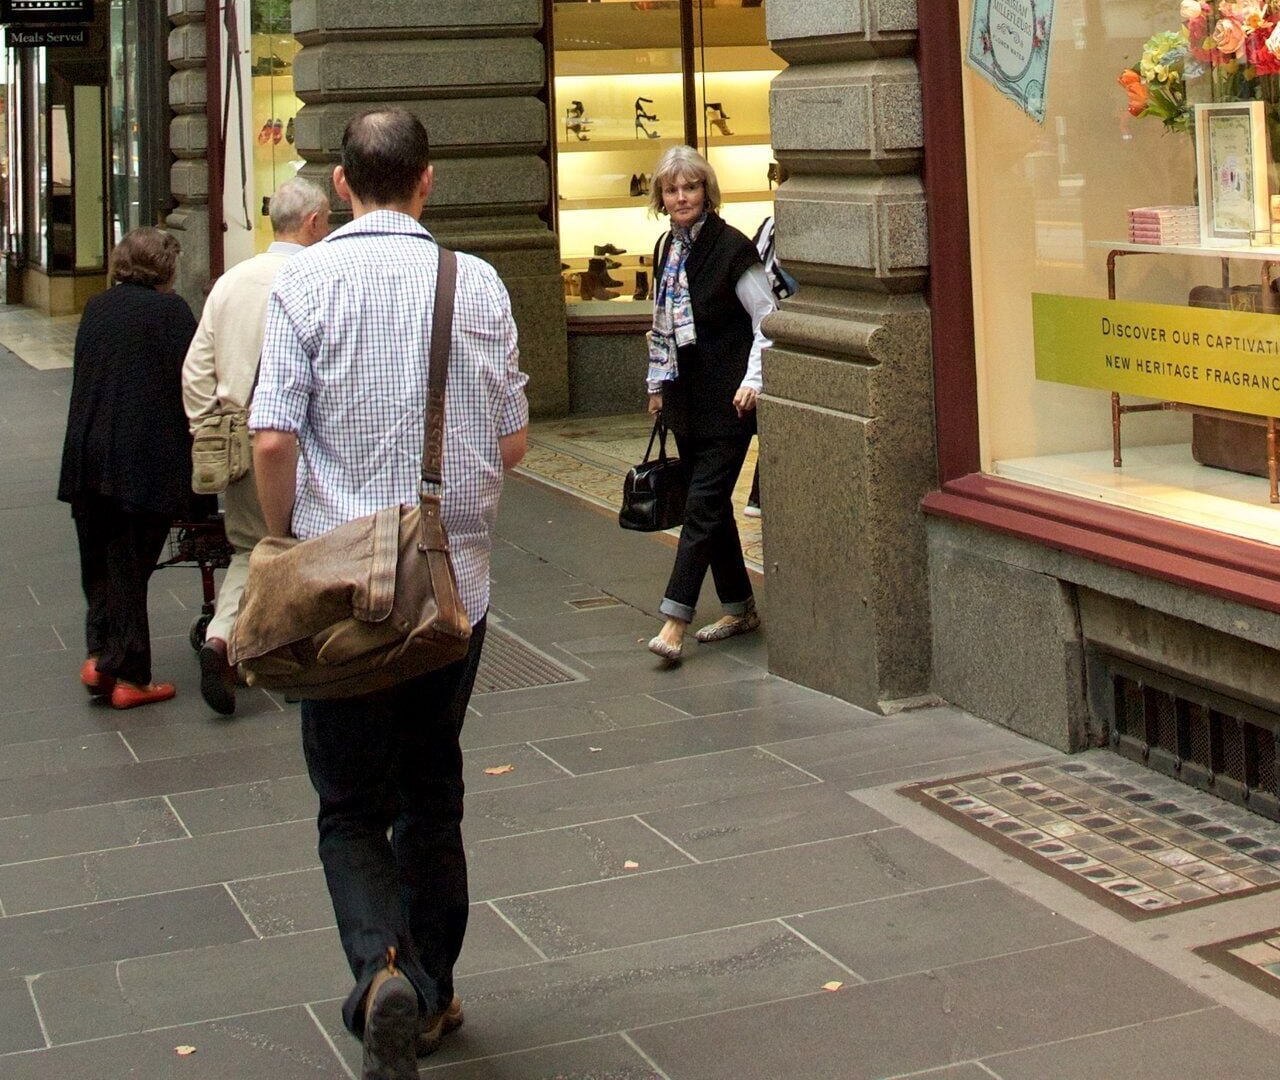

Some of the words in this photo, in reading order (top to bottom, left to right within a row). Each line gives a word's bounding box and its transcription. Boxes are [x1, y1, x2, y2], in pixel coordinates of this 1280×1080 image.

[993, 0, 1032, 37] MILLEFLEURS
[11, 32, 43, 42] Meals
[46, 31, 84, 42] Served
[1101, 317, 1166, 343] DISCOVER
[1172, 330, 1200, 346] OUR
[1105, 354, 1130, 370] NEW
[1136, 360, 1199, 380] HERITAGE
